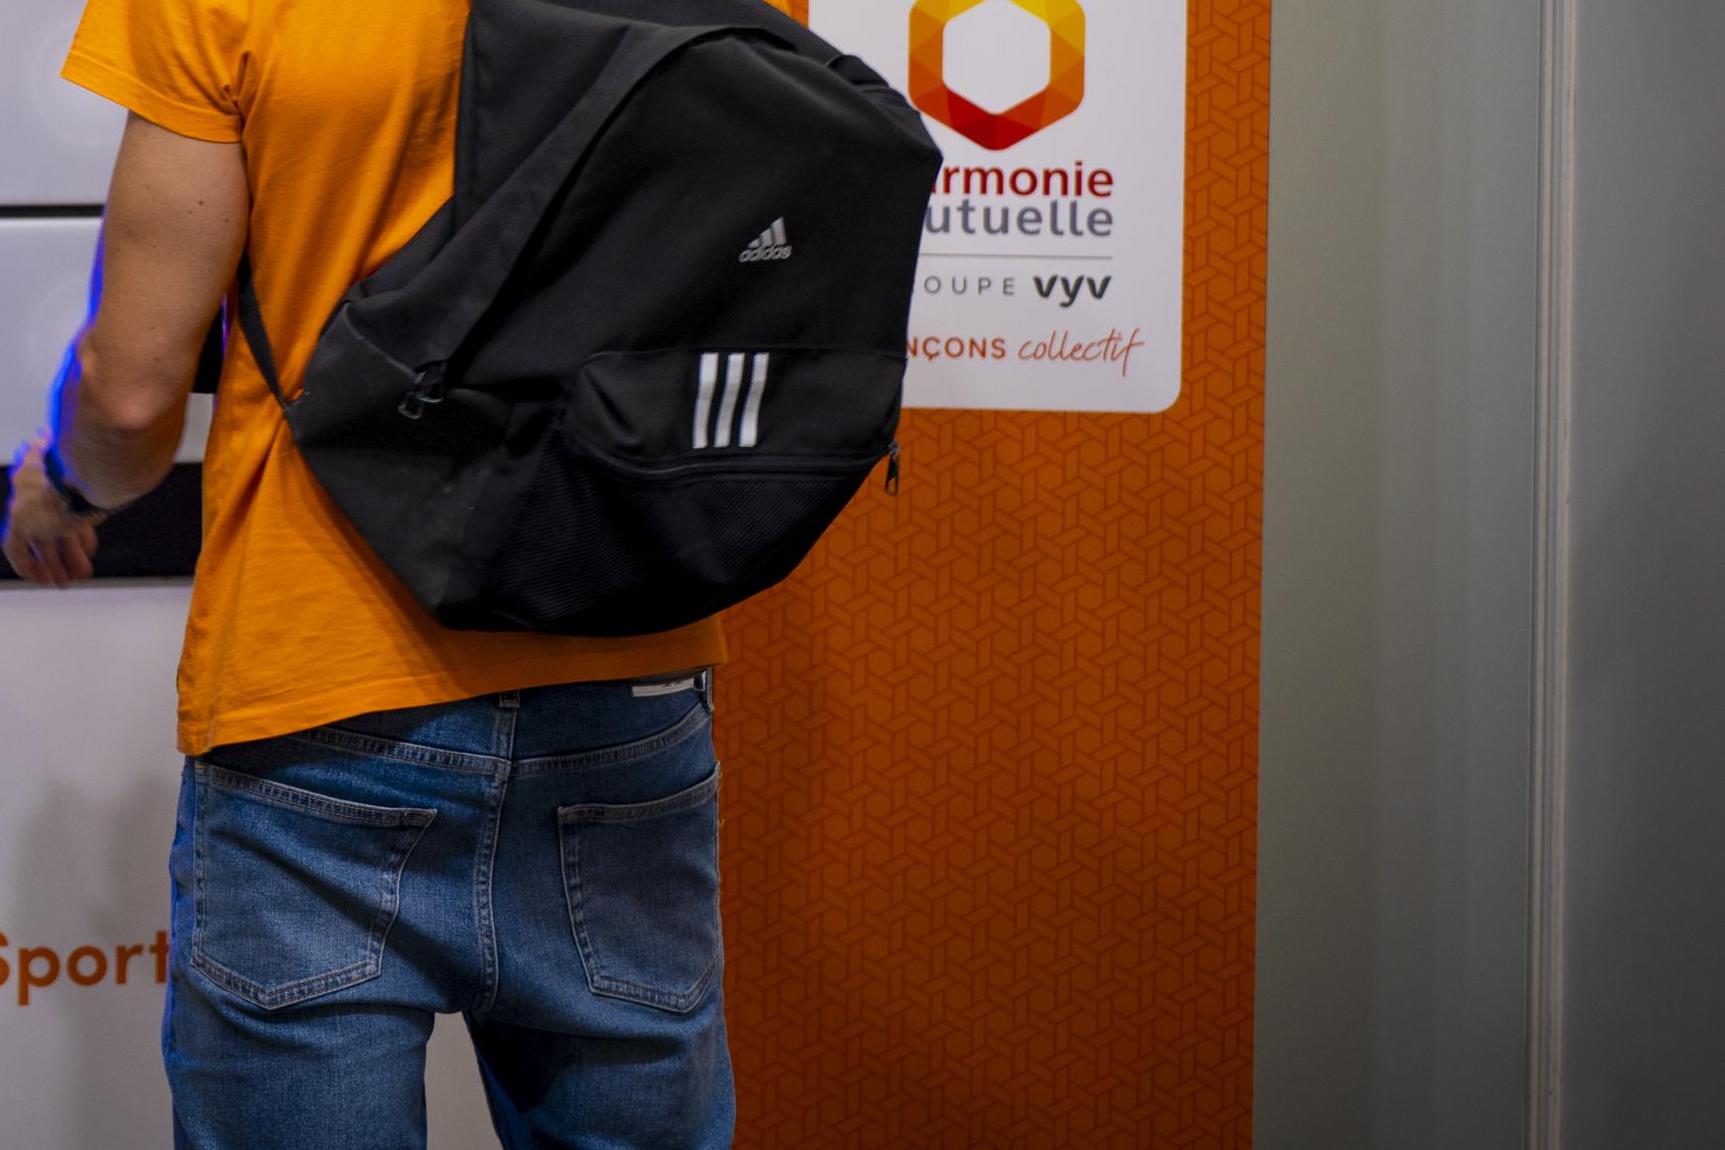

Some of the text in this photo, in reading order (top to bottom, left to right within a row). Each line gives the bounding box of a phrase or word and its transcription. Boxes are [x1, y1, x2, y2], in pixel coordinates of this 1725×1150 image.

[931, 161, 1114, 197] rmonie
[925, 199, 1114, 236] utuelle
[738, 245, 793, 263] adidas
[923, 274, 1113, 308] OUPE vyv
[1018, 327, 1145, 378] collectif
